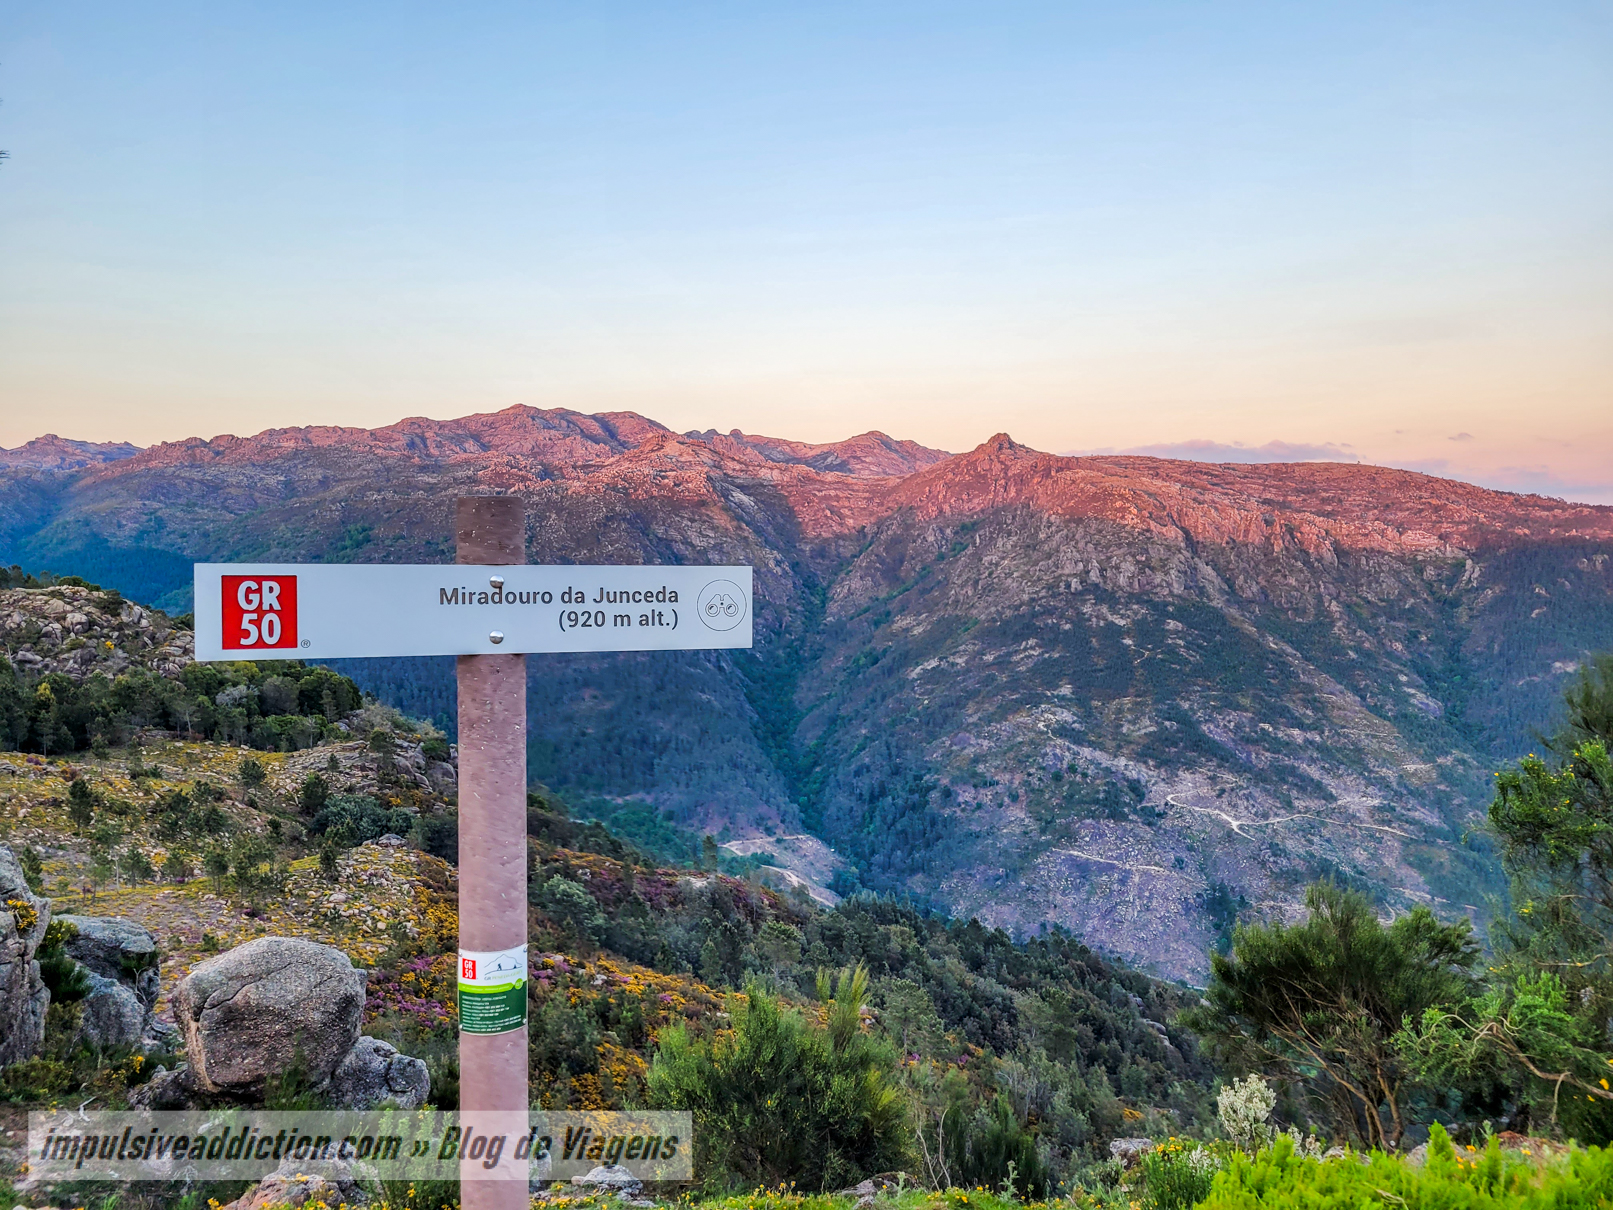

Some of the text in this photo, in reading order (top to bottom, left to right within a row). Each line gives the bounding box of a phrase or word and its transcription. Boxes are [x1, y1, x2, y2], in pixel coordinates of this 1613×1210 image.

[237, 580, 282, 611] GR
[439, 585, 679, 605] Miradouro da Junceda
[239, 612, 282, 646] 50
[558, 608, 679, 632] (920 m alt.)
[464, 960, 473, 969] GR
[464, 970, 473, 978] 50
